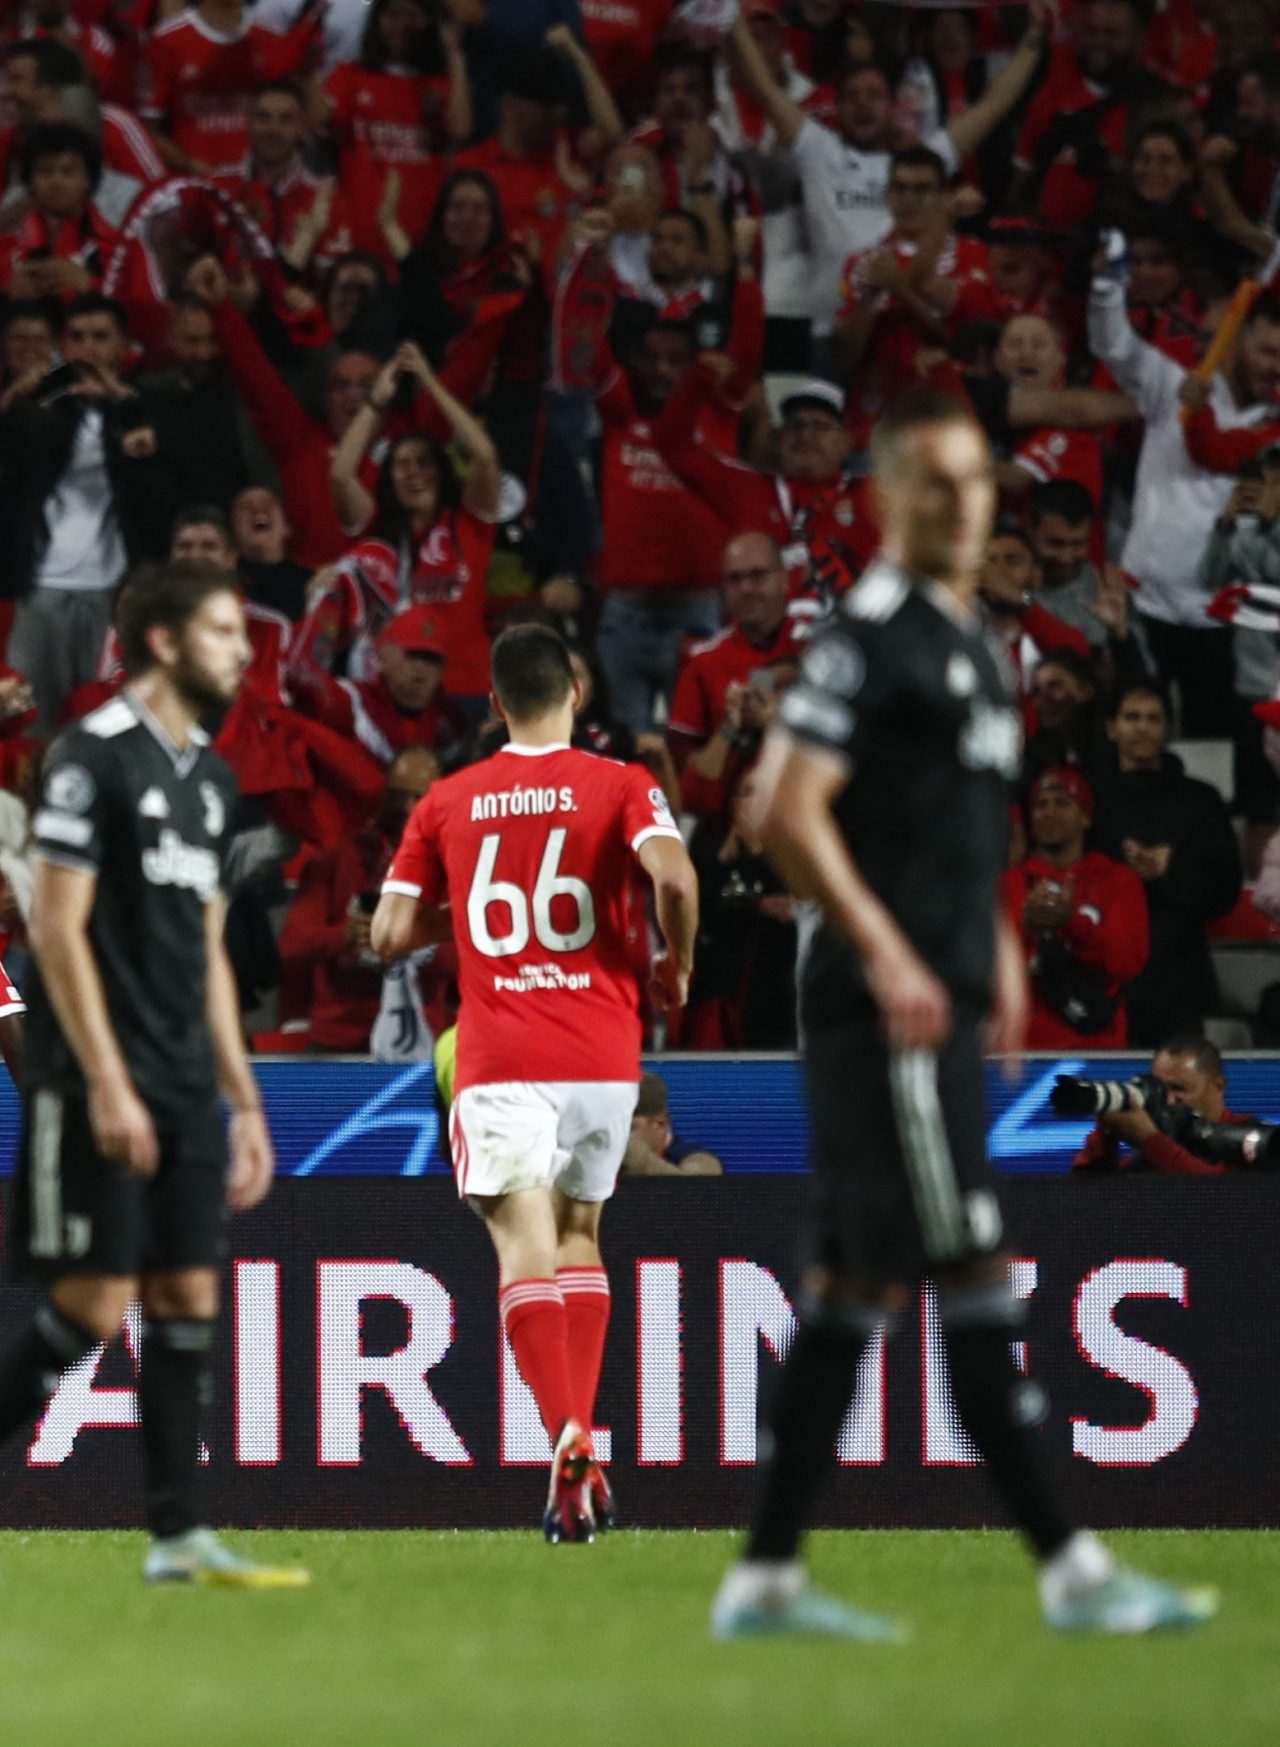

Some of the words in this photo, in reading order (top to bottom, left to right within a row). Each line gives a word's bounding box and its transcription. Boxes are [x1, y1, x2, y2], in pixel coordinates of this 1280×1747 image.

[471, 785, 557, 821] ANTÓNIO
[559, 786, 578, 812] S.
[467, 827, 596, 957] 66
